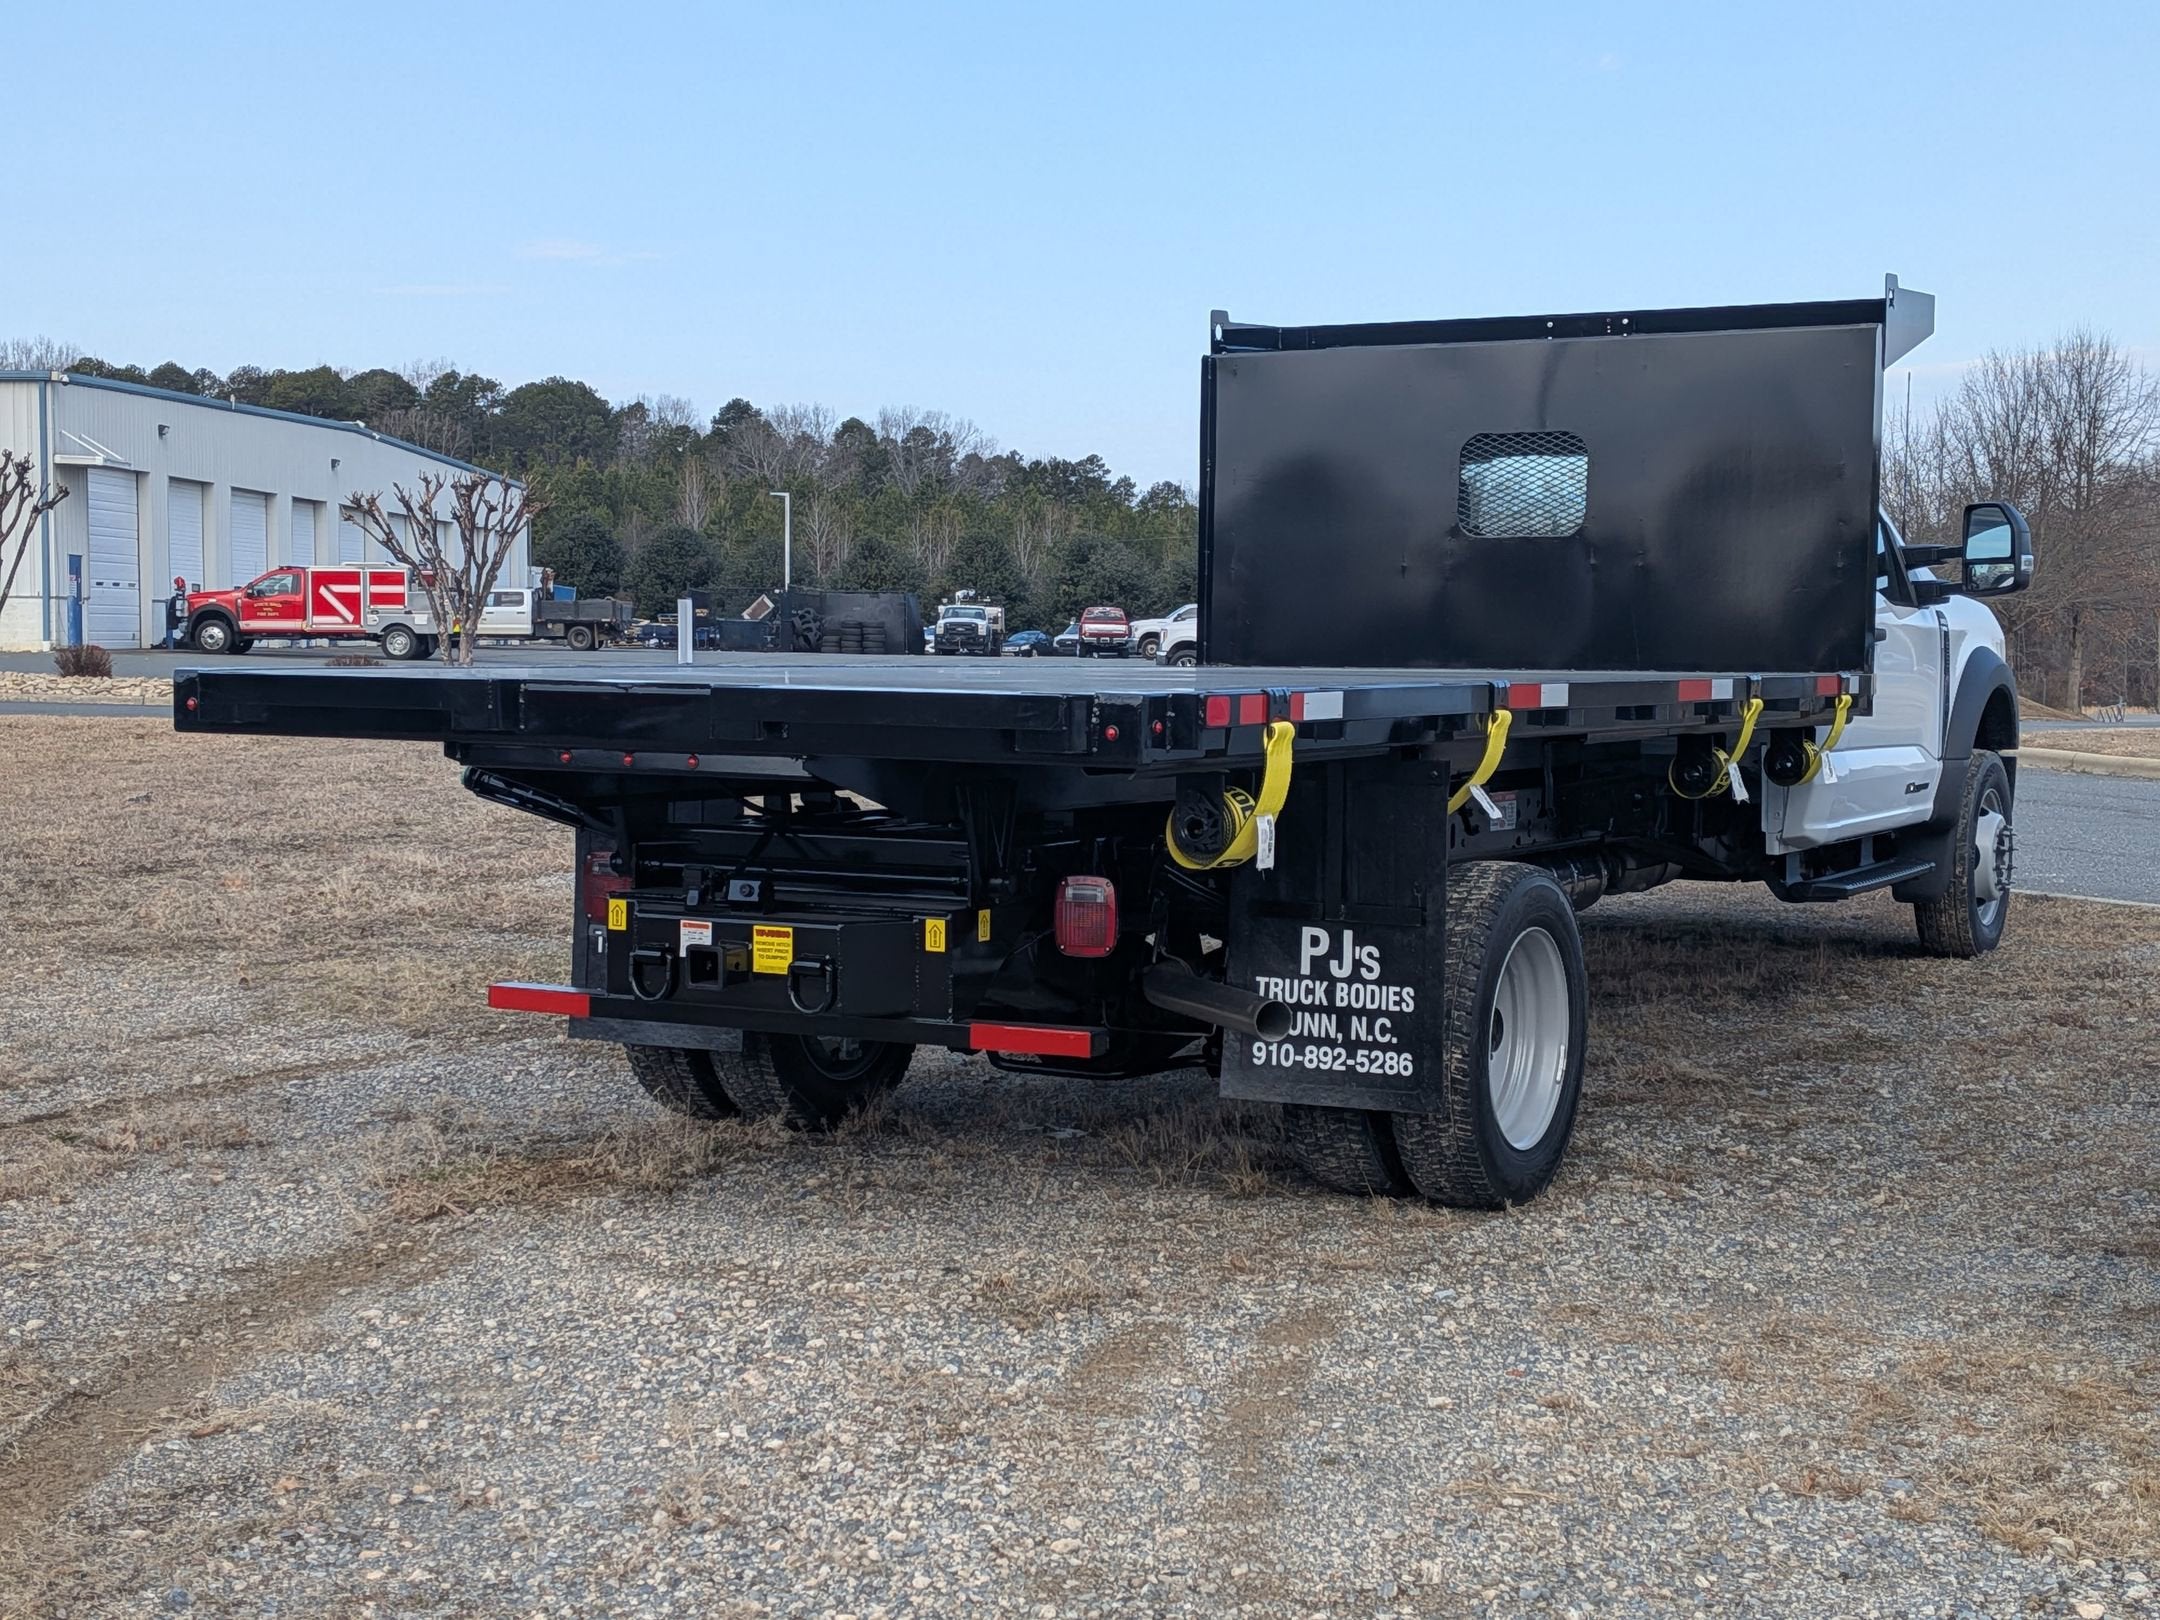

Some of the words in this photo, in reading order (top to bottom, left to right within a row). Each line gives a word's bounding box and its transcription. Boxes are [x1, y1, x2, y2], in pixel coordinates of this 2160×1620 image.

[1255, 976, 1328, 1006] TRUCK
[1335, 982, 1415, 1013] BODIES
[1287, 1011, 1343, 1044] UNN,
[1350, 1015, 1398, 1044] N.C.
[1251, 1041, 1414, 1077] 910-892-5286
